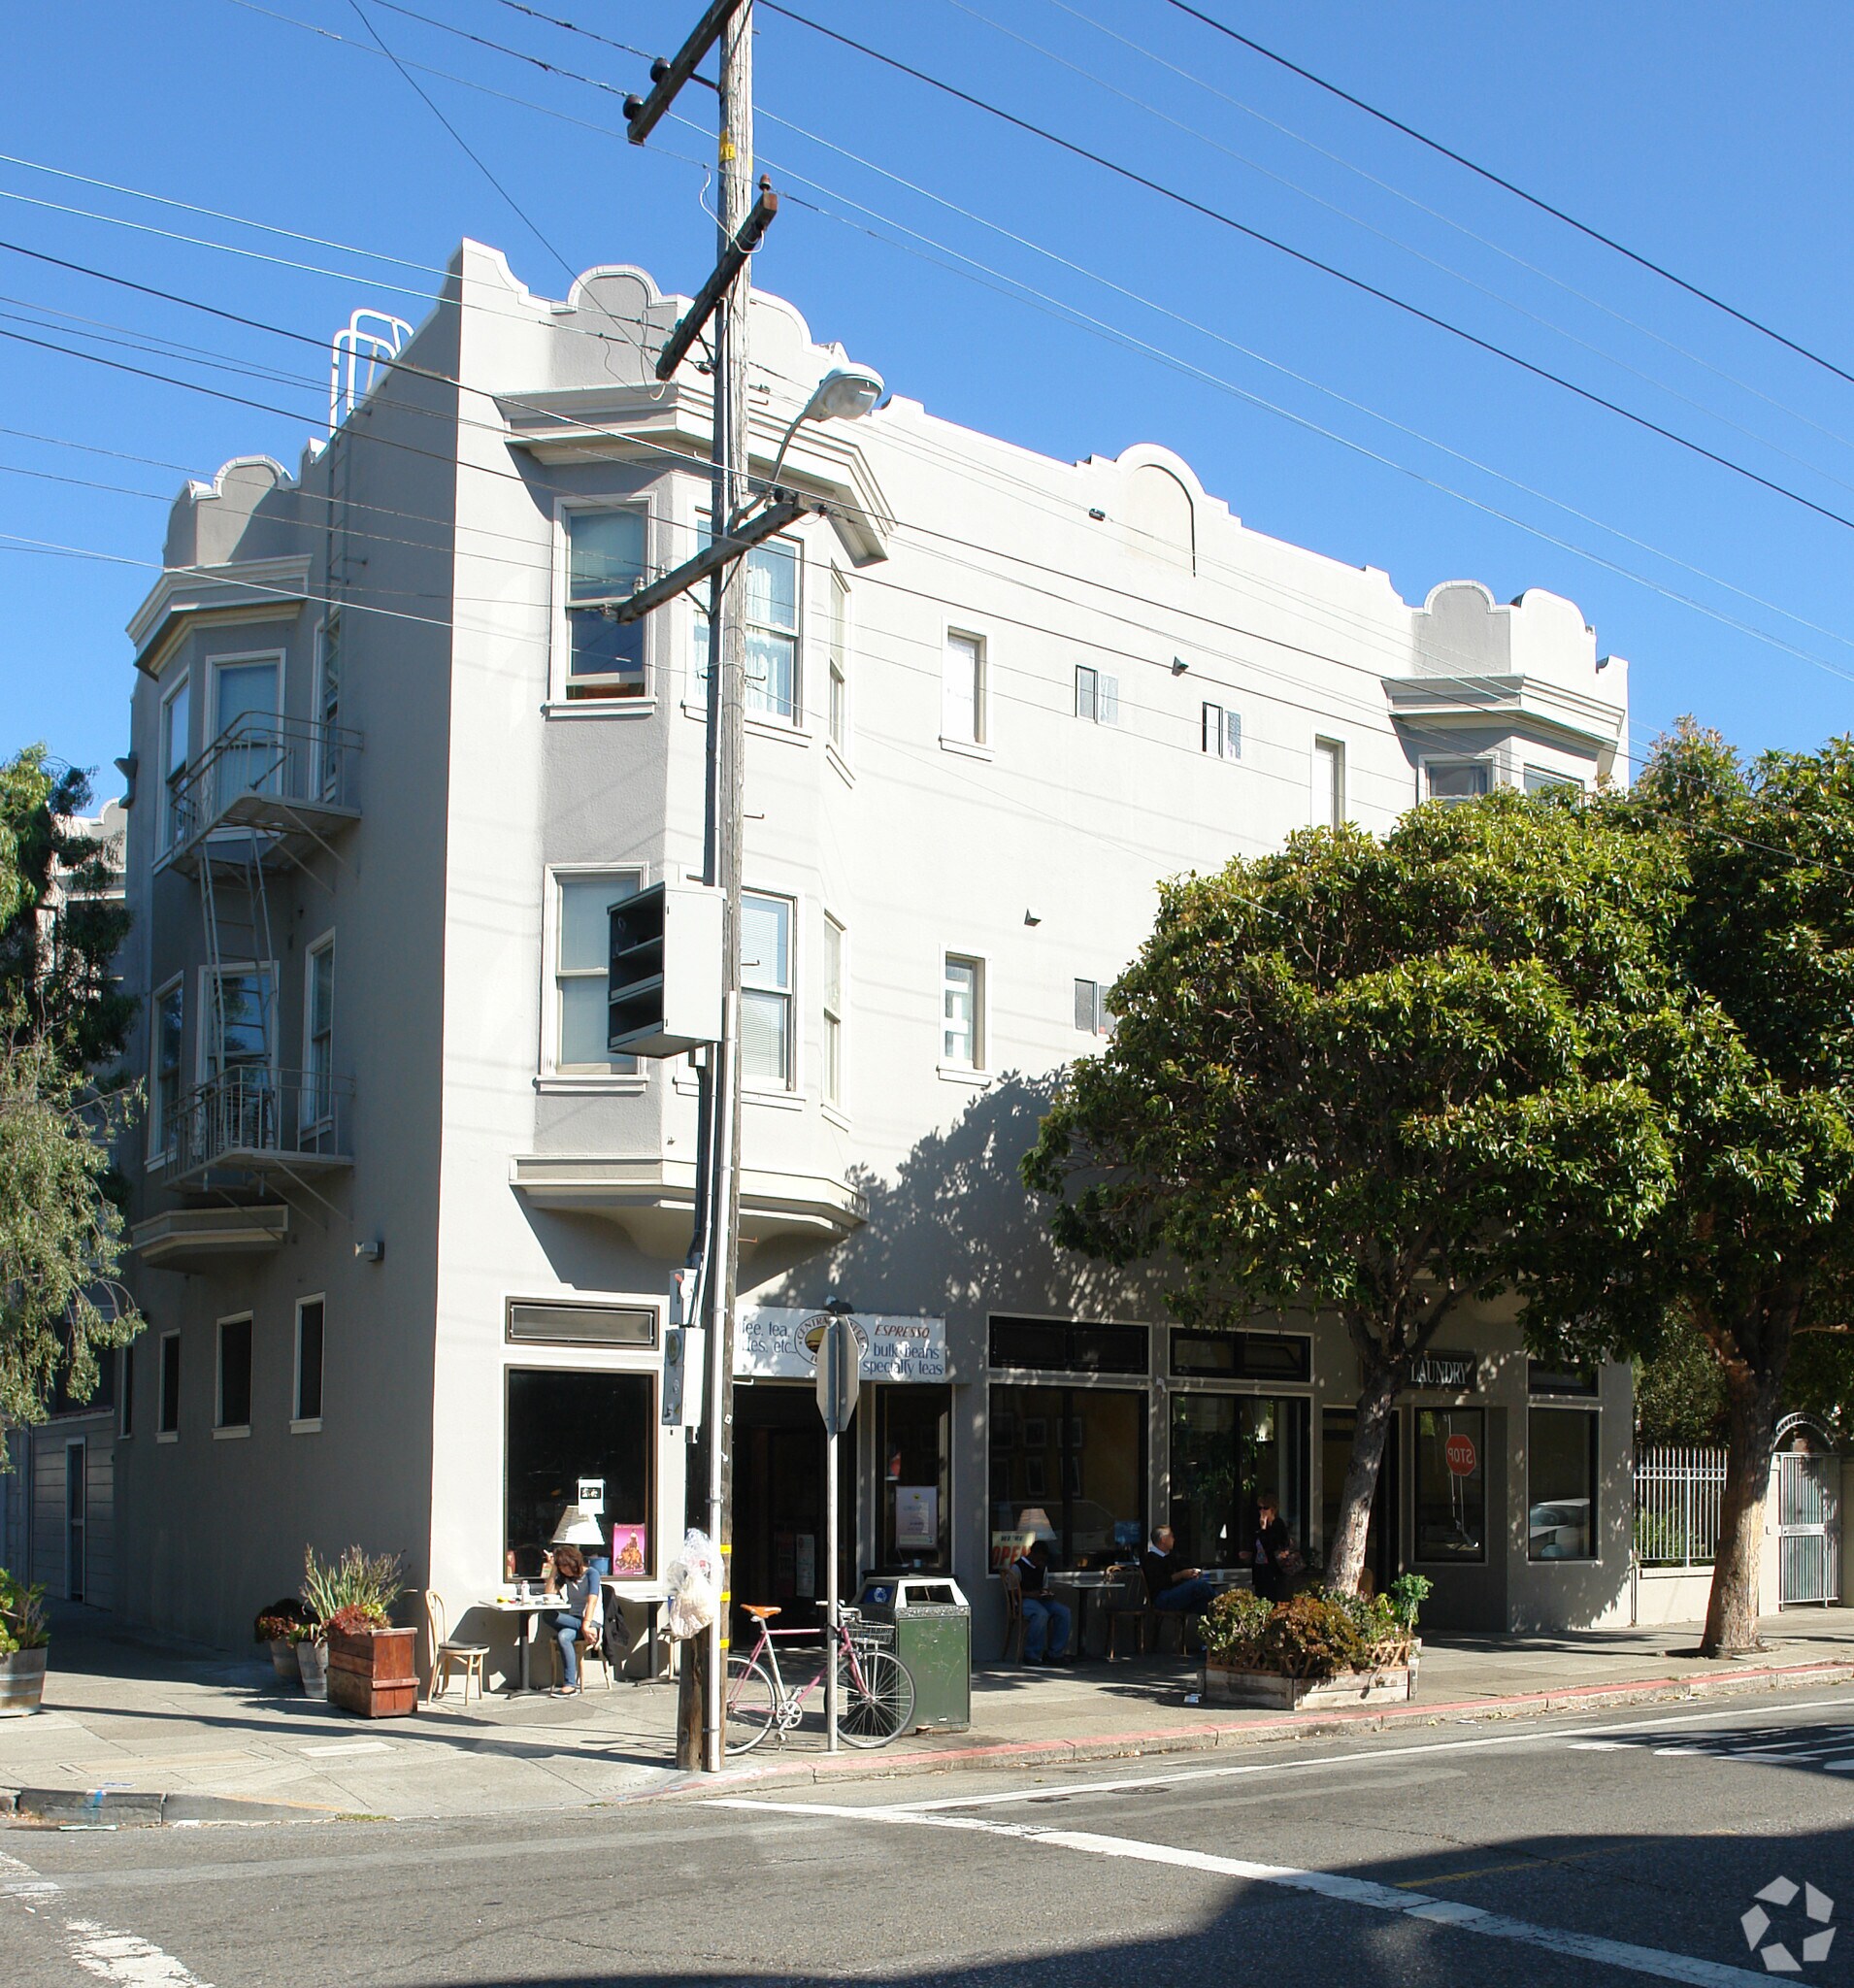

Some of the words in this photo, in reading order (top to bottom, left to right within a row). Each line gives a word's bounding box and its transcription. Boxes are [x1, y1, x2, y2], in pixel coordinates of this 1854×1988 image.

[875, 1324, 930, 1339] ESPRESSO
[874, 1342, 899, 1357] bulk
[905, 1344, 940, 1359] beans
[863, 1359, 914, 1377] specialty
[919, 1360, 944, 1375] teas
[1410, 1360, 1469, 1384] LAUNDRY
